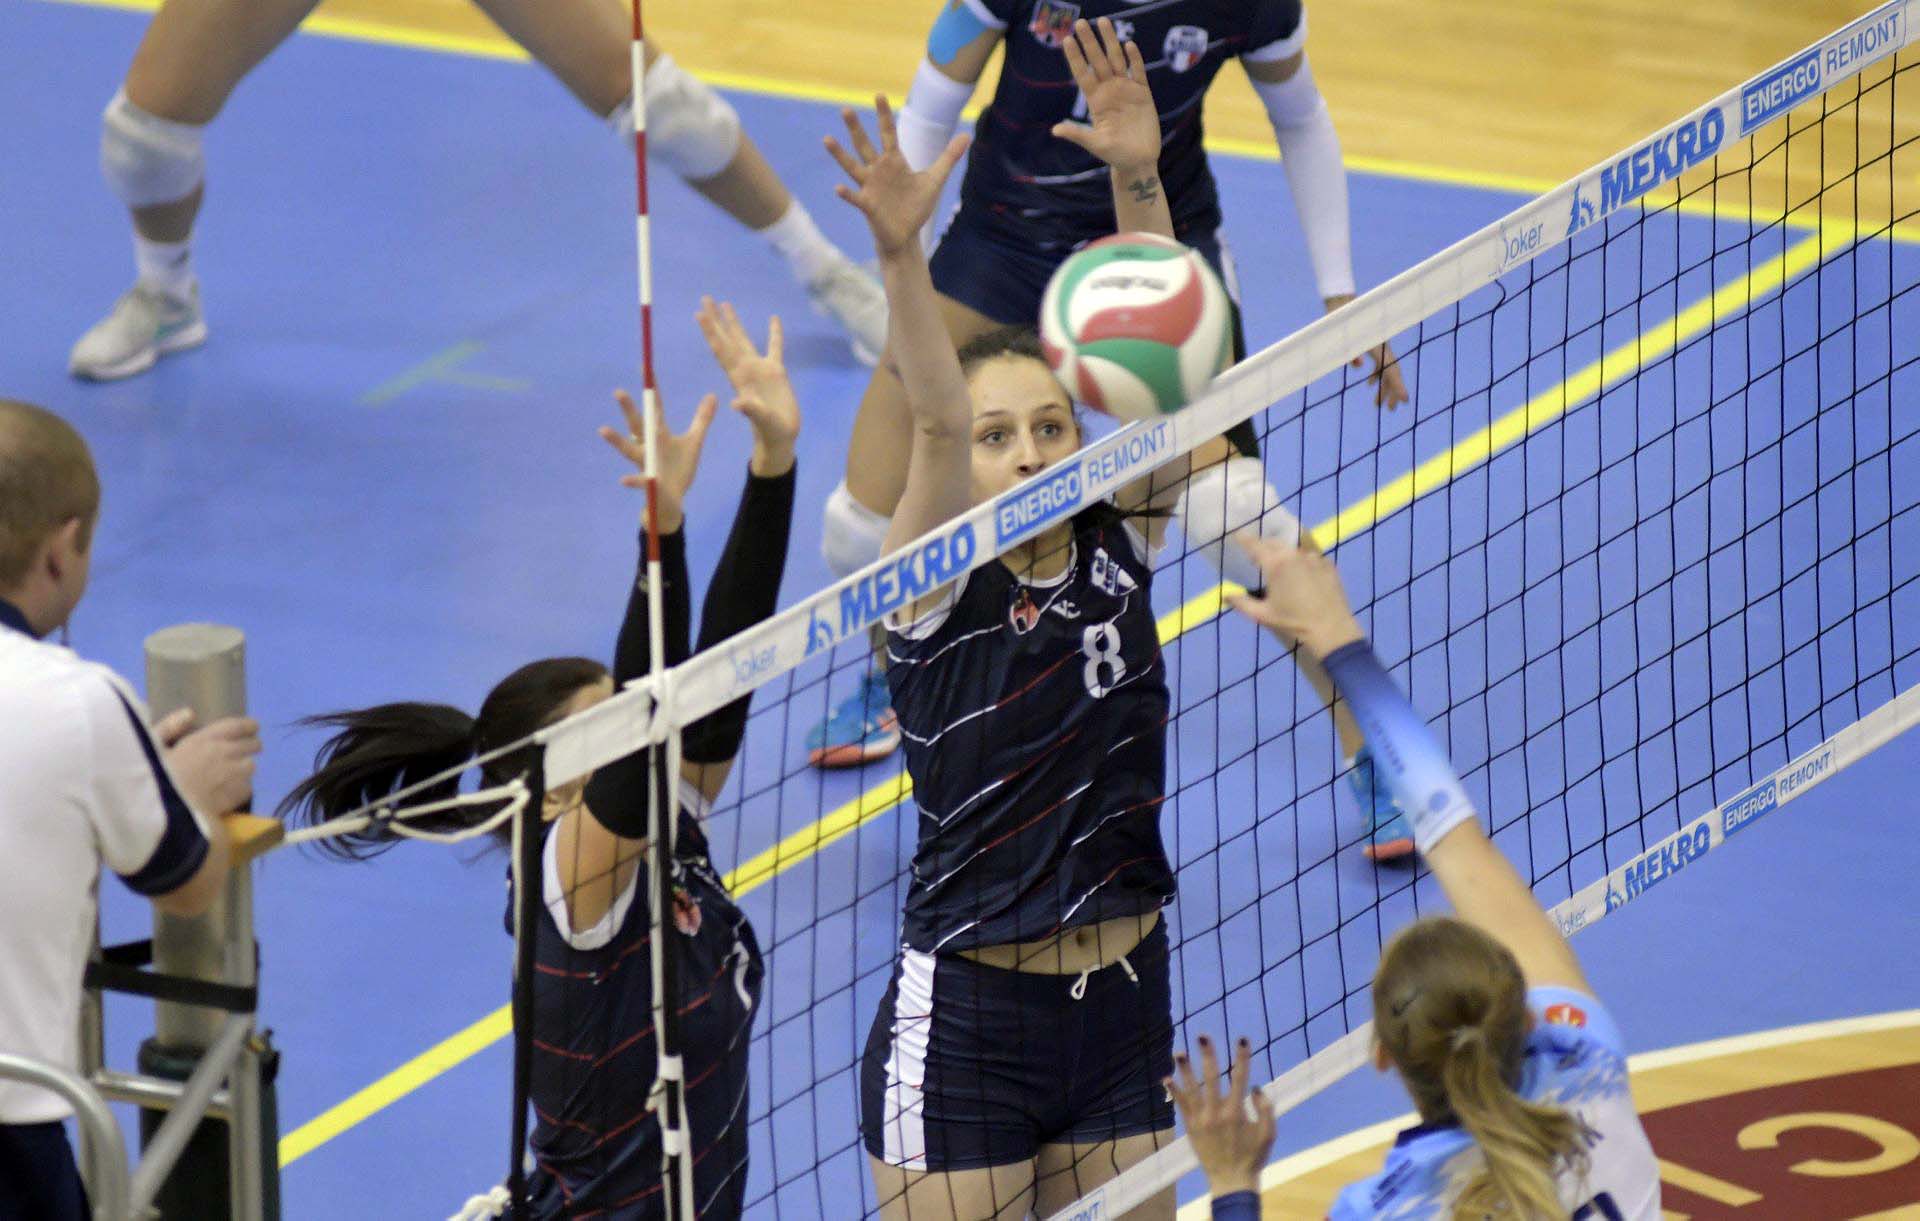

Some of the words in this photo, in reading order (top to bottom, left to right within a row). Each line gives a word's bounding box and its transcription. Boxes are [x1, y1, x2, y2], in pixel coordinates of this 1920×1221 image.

[1601, 107, 1724, 215] MEKRO
[1747, 58, 1819, 121] ENERGO
[1826, 12, 1899, 75] REMONT
[839, 521, 976, 639] MEKRO
[1001, 470, 1081, 535] ENERGO
[1087, 422, 1167, 489] REMONT
[1083, 623, 1127, 699] 8
[1624, 822, 1710, 901] MEKRO
[1726, 785, 1776, 831] ENERGO
[1779, 751, 1831, 797] REMONT
